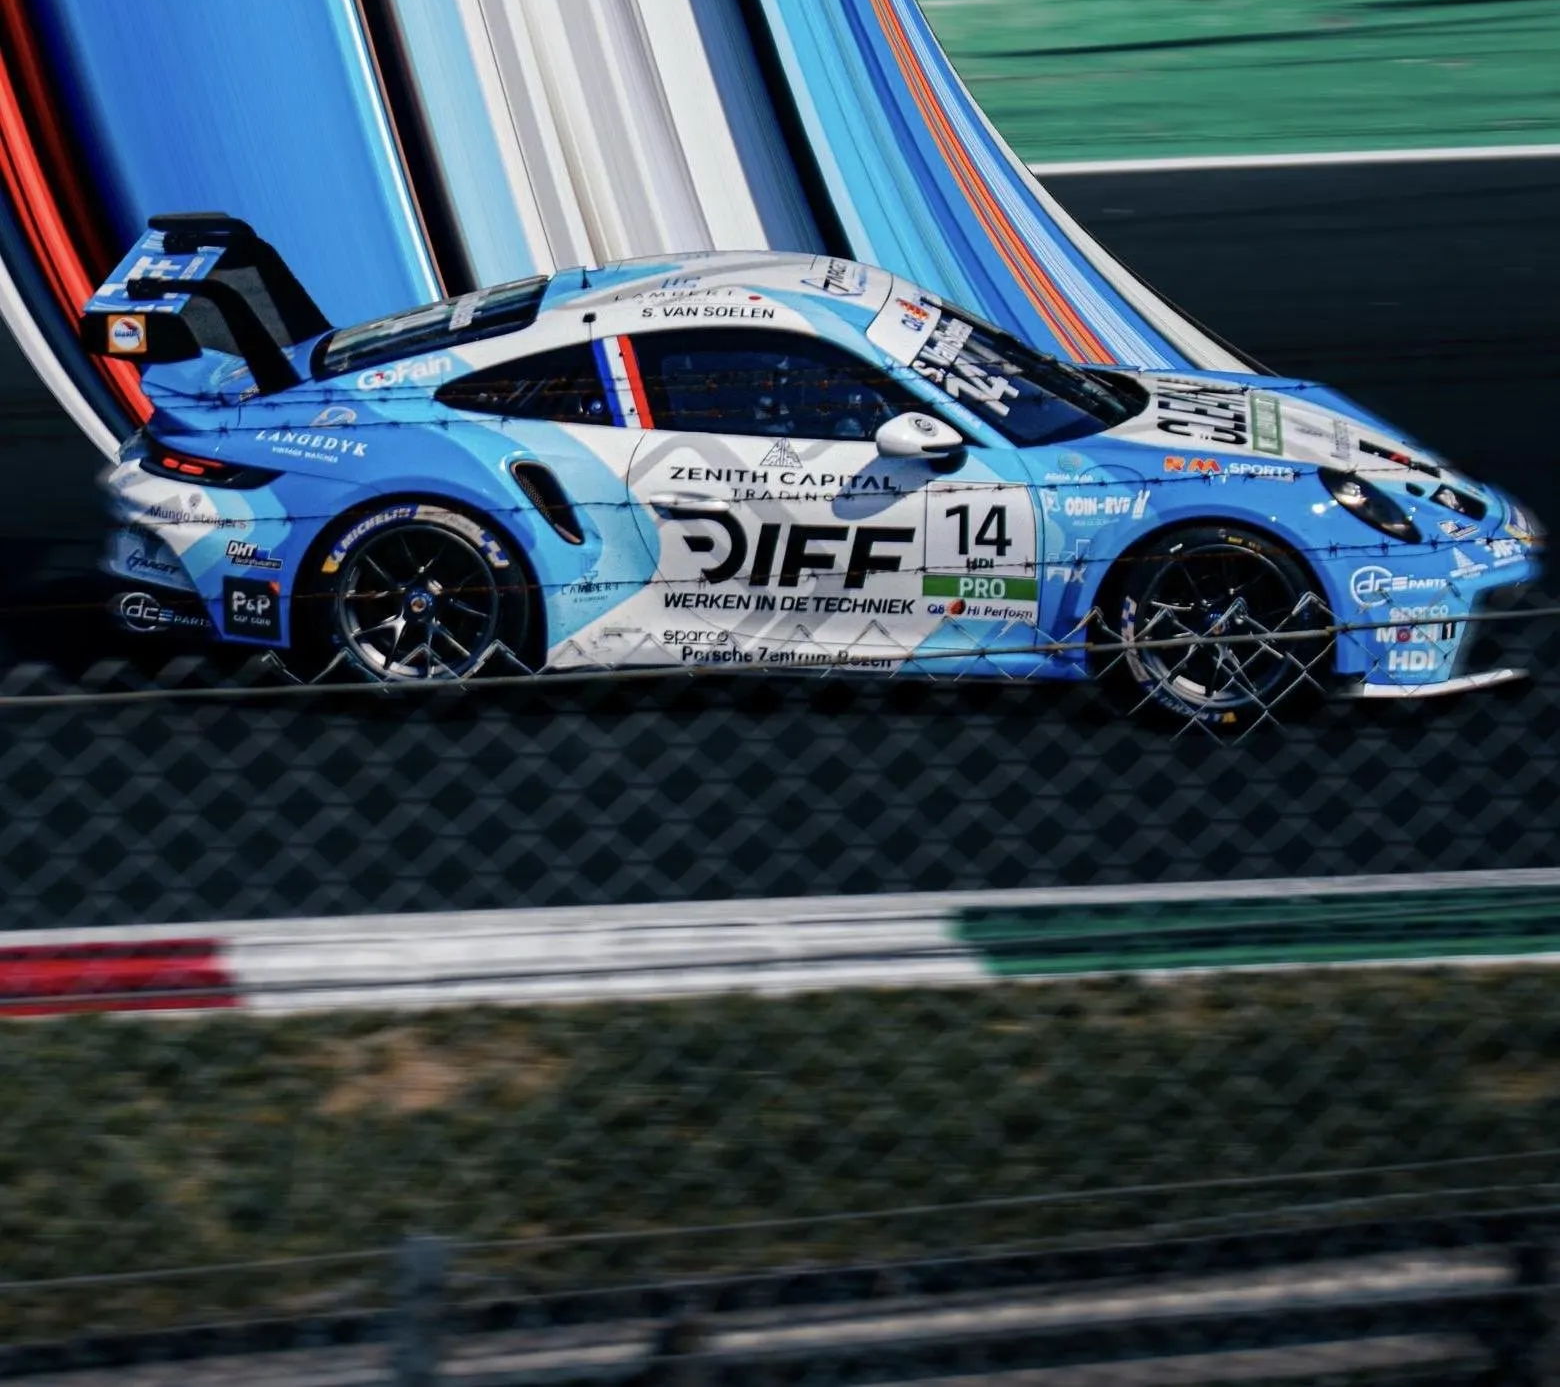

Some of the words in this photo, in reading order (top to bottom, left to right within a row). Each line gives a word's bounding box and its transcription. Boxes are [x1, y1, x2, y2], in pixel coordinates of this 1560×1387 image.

[642, 307, 657, 318] S.
[663, 307, 698, 318] VAN
[703, 306, 775, 319] SOELEN
[255, 430, 368, 457] LANGEDYK
[670, 466, 768, 484] ZENITH
[780, 471, 898, 491] CAPITAL
[150, 505, 190, 523] Mundo
[945, 504, 1012, 556] 14
[228, 541, 257, 557] DHT
[959, 577, 1006, 598] PRO
[1408, 578, 1447, 589] PARTS
[664, 592, 751, 610] WERKEN
[755, 594, 776, 611] IN
[780, 595, 809, 612] DE
[813, 596, 916, 615] TECHNIEK
[927, 604, 945, 615] Q8
[967, 605, 980, 616] Hi
[663, 628, 729, 645] sparco
[682, 645, 753, 662] Porsche
[1388, 649, 1436, 671] HDI
